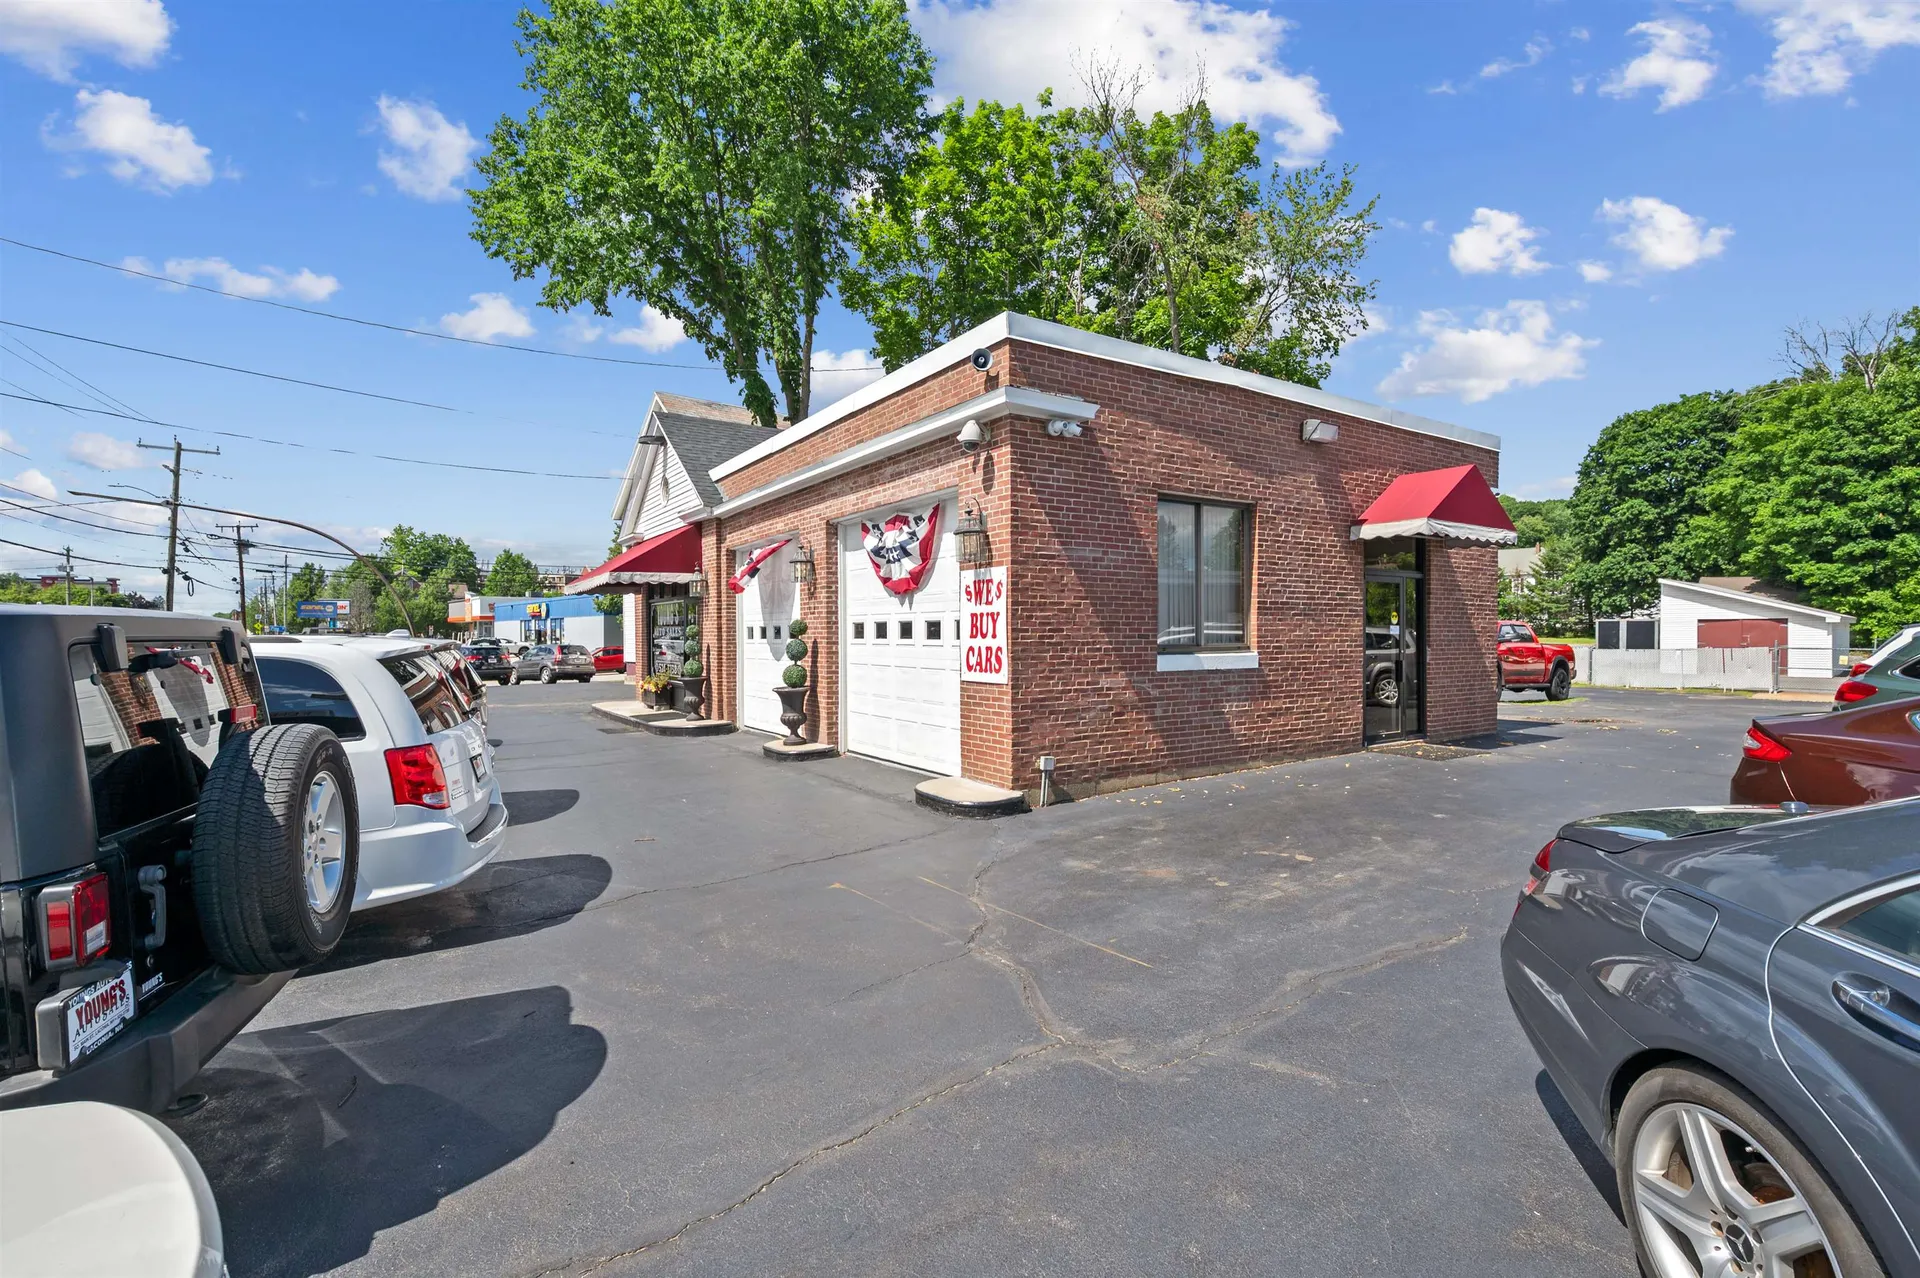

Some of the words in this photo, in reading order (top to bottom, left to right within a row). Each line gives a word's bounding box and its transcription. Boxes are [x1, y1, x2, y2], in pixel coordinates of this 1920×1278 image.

[969, 611, 1001, 640] BUY
[965, 645, 1003, 674] CARS
[75, 978, 127, 1031] YOUNG'S
